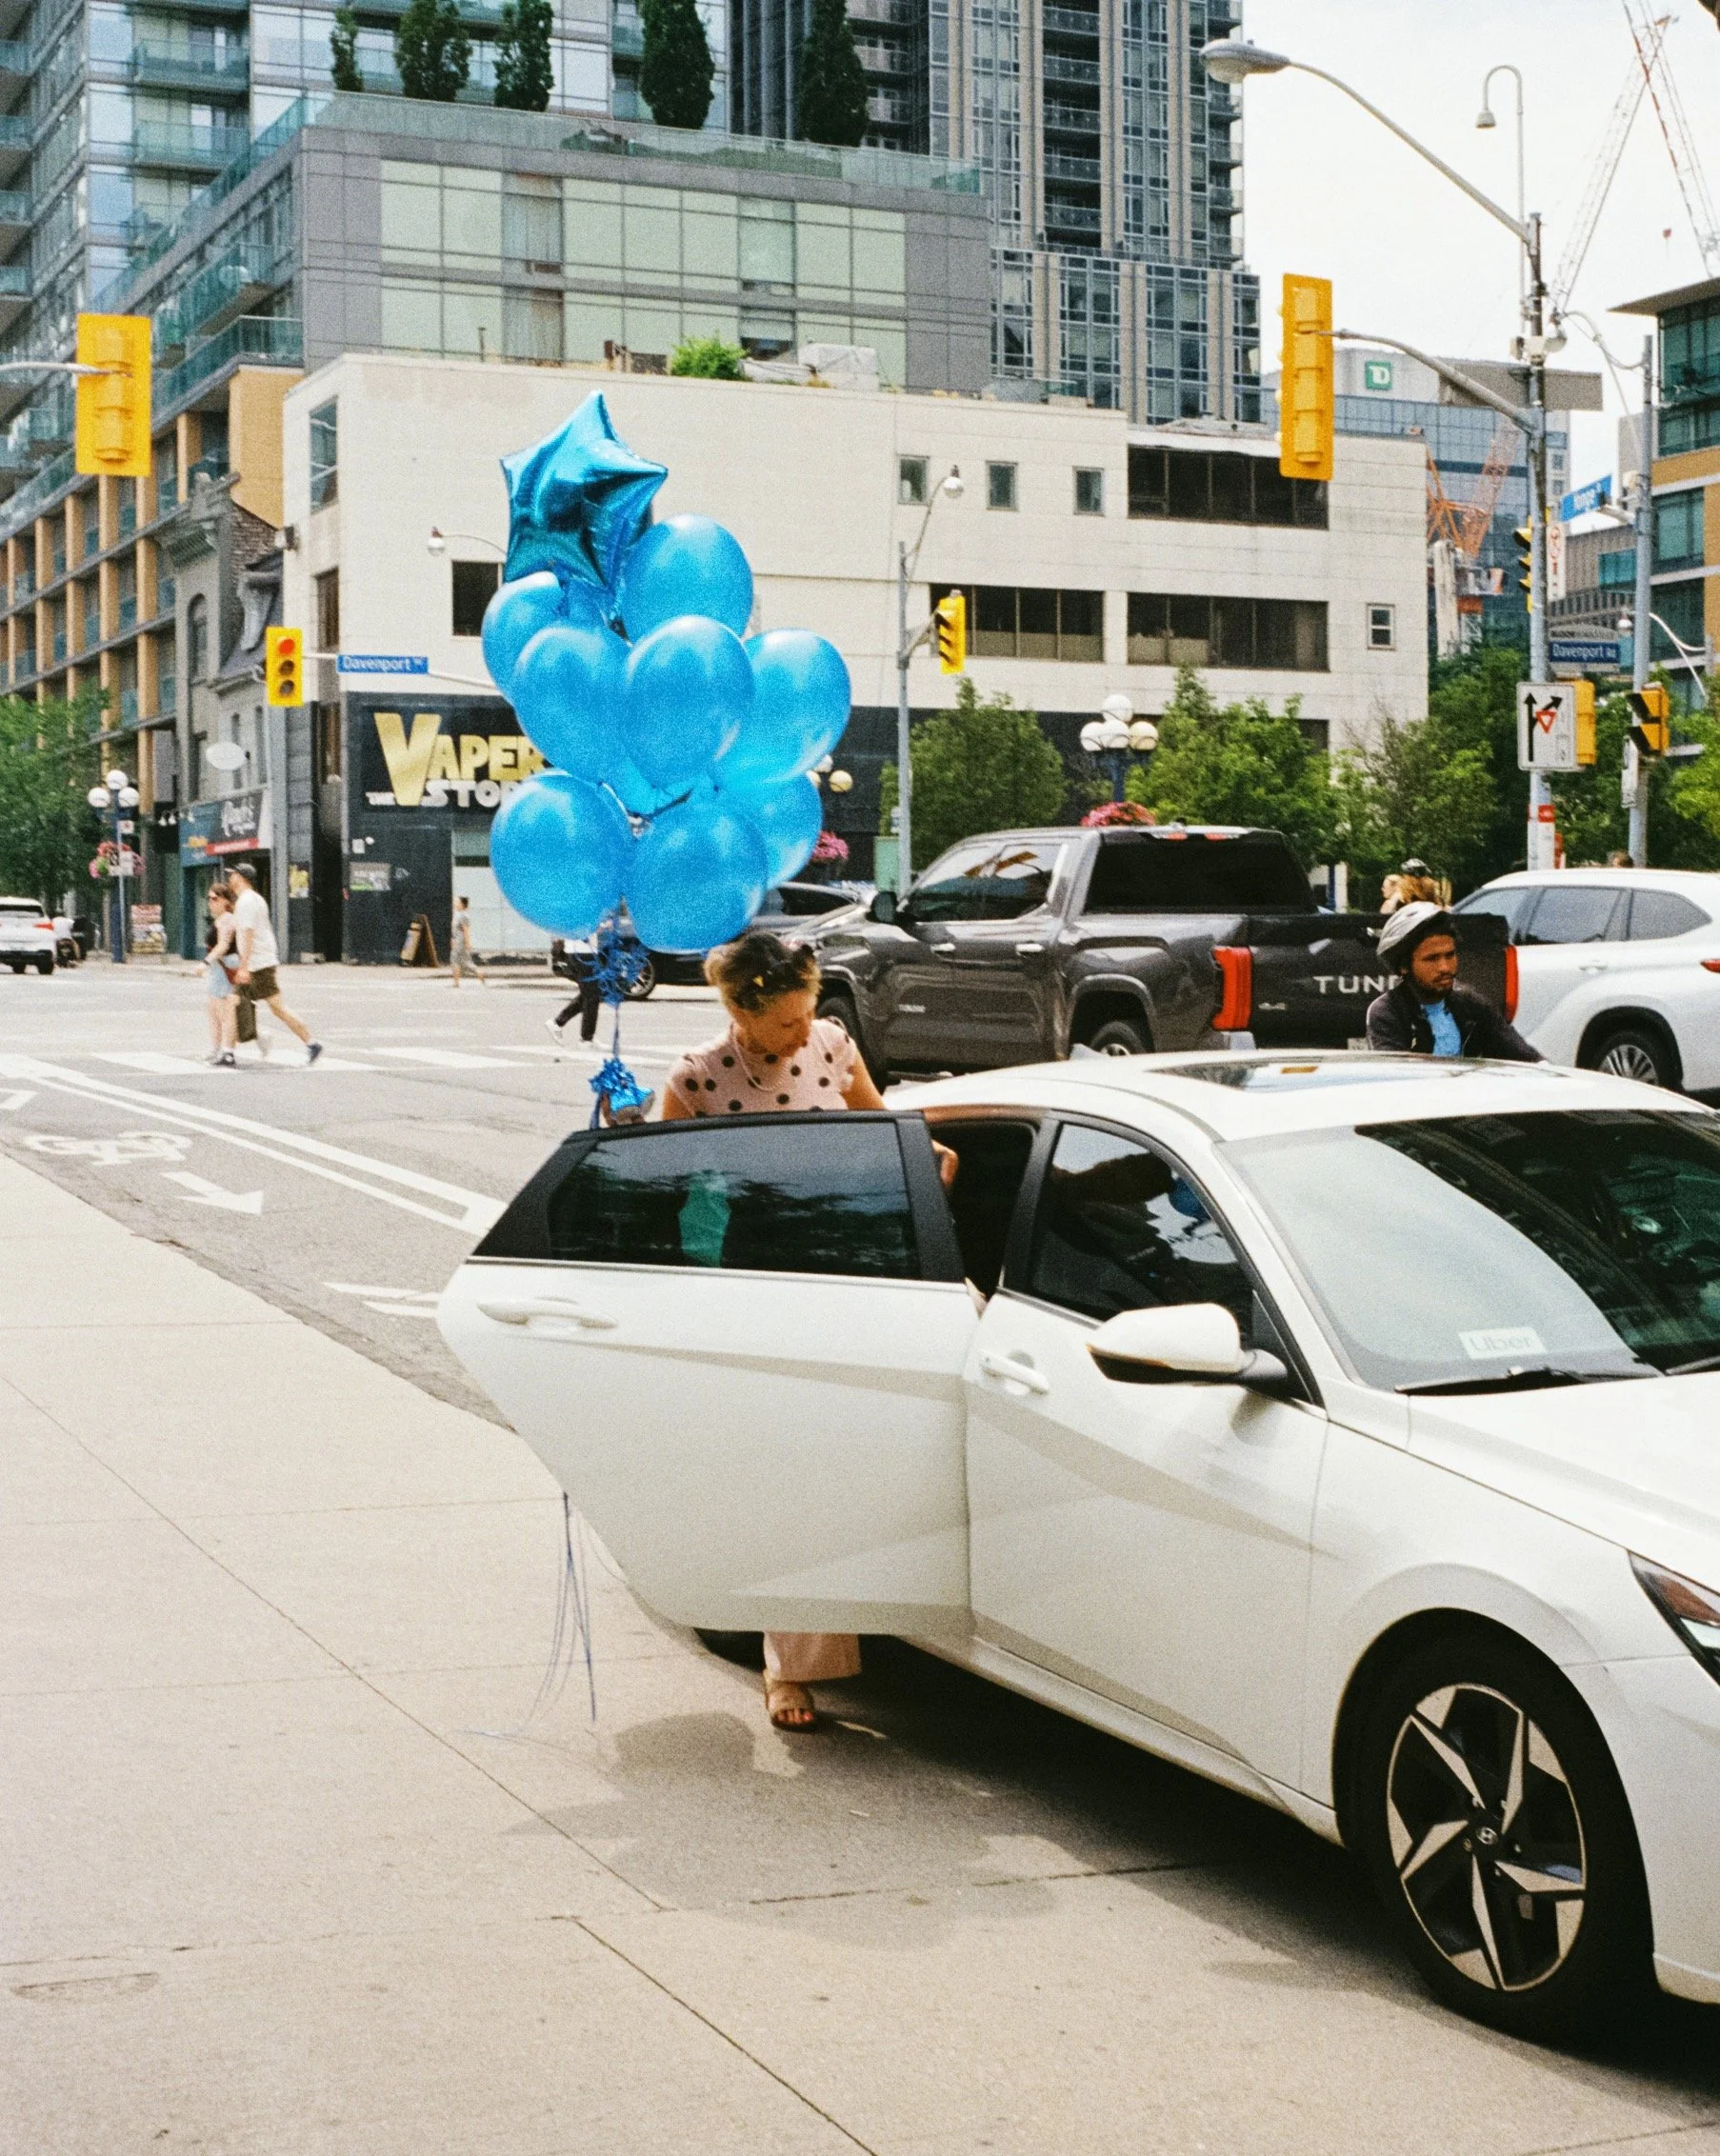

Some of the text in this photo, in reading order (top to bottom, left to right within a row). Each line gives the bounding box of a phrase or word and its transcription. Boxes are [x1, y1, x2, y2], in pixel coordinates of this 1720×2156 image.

[1368, 365, 1390, 385] TD
[1552, 643, 1604, 661] Davenport
[344, 655, 411, 672] Davenport
[1468, 1335, 1531, 1351] Uber
